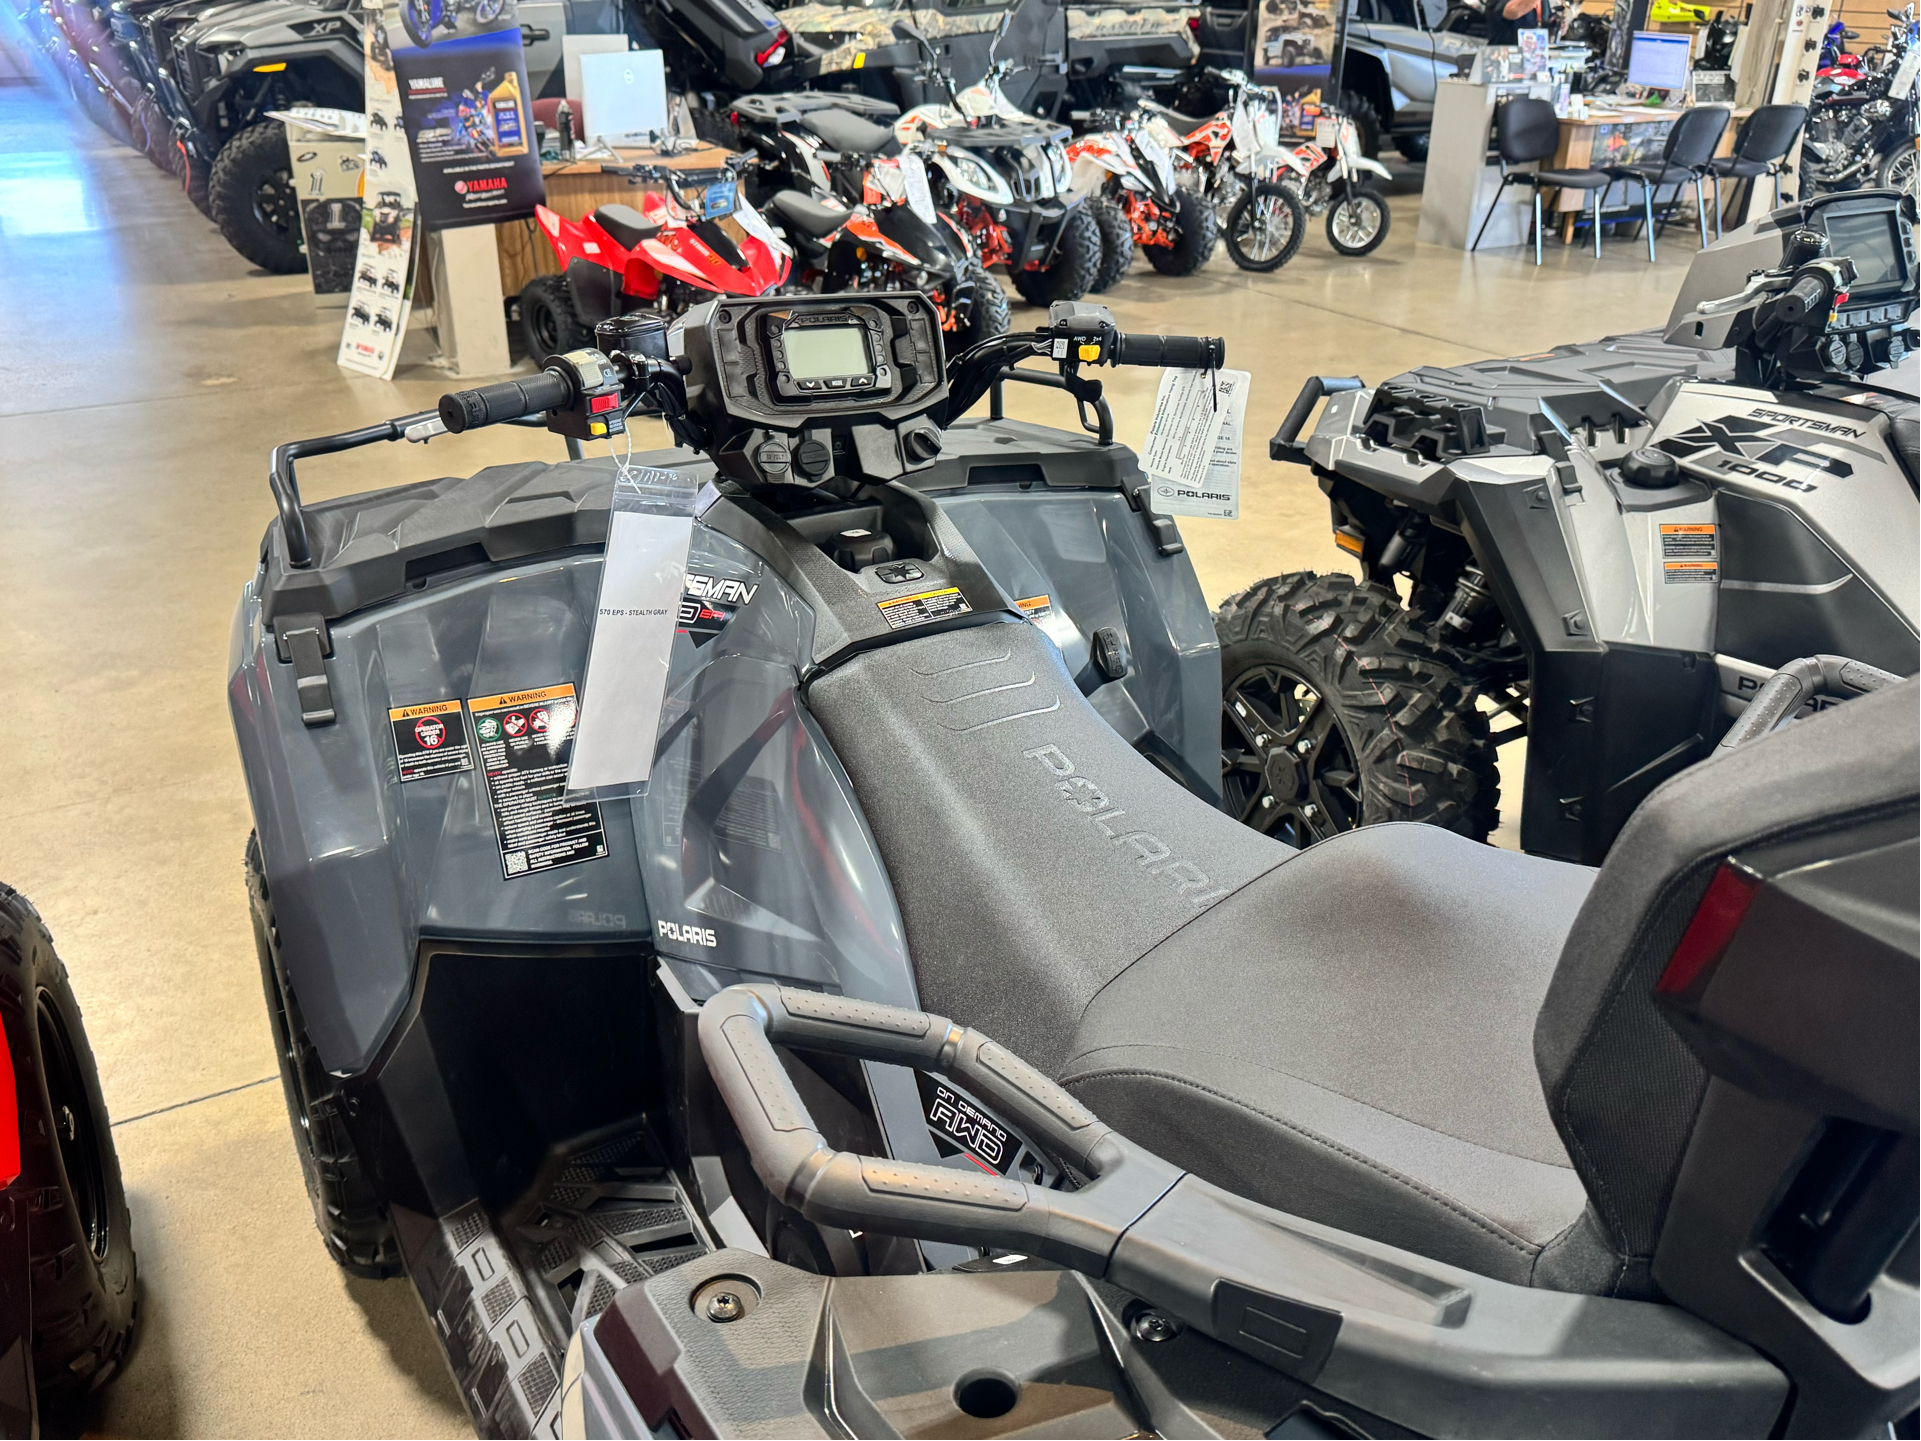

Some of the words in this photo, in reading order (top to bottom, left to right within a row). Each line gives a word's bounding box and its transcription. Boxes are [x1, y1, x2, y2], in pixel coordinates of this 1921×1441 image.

[308, 21, 341, 35] XP
[467, 177, 508, 192] YAMAHA
[800, 314, 847, 323] POLARIS
[1748, 408, 1866, 439] SPORTSMAN
[1650, 415, 1854, 479] XP
[1717, 459, 1818, 493] 1000
[1177, 489, 1232, 501] POLARIS
[508, 691, 547, 703] WARNING
[410, 704, 448, 715] WARNING
[415, 723, 444, 732] OPERATOR
[421, 729, 440, 737] UNDER
[424, 735, 438, 745] 16
[1022, 743, 1230, 908] POLARI
[658, 920, 717, 947] POLARIS
[937, 1087, 955, 1103] ON
[958, 1100, 1007, 1141] DEMAND
[930, 1098, 1003, 1164] AWD
